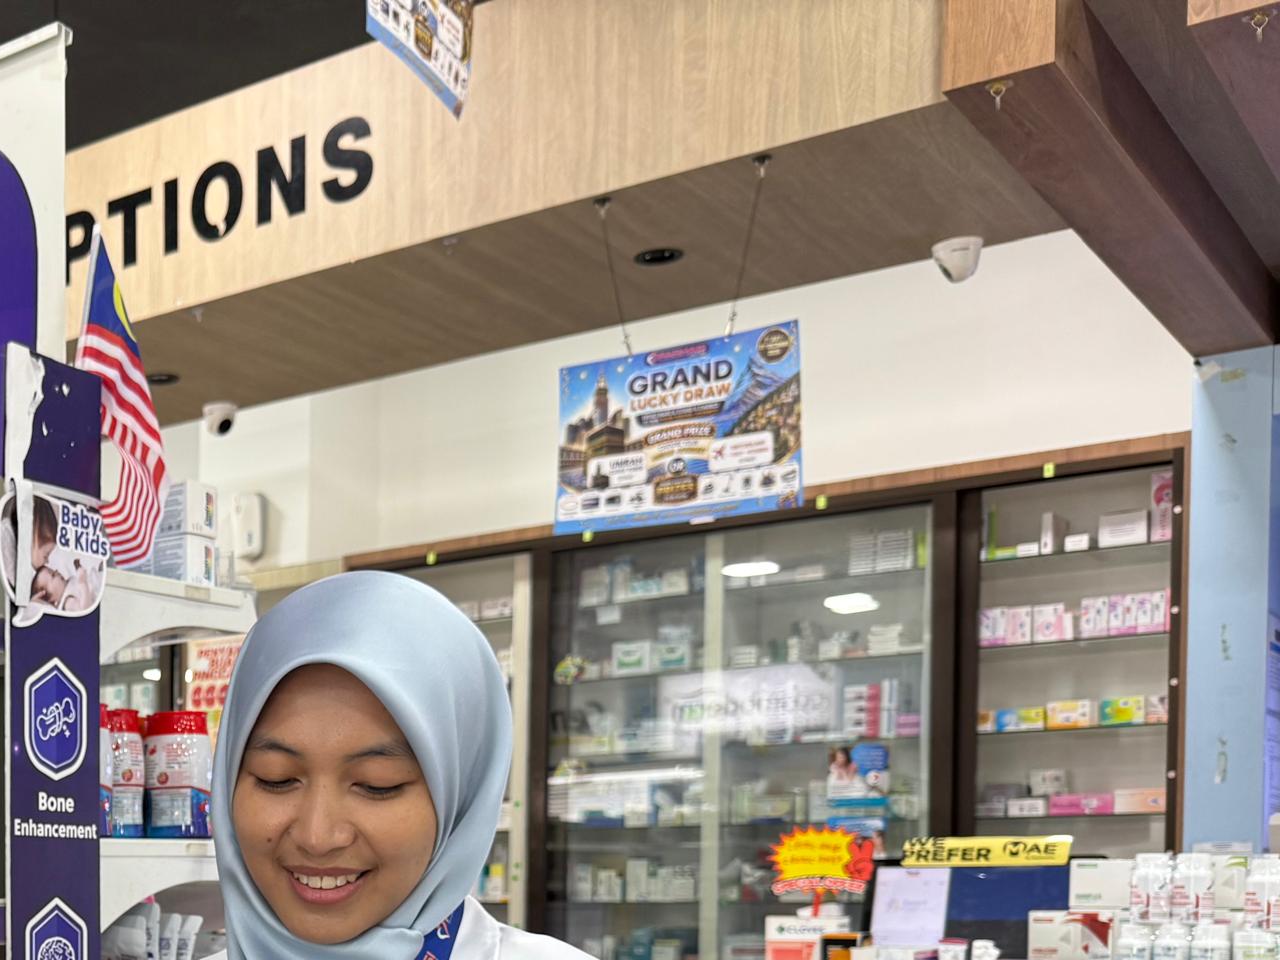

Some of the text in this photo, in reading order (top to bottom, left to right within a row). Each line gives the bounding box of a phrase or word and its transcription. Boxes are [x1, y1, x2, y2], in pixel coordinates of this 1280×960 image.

[66, 116, 374, 287] PTIONS
[629, 360, 733, 395] GRAND
[631, 382, 731, 412] LUCKY DRAW
[61, 504, 101, 534] Baby
[59, 530, 108, 557] & Kids
[38, 791, 75, 813] Bone
[14, 818, 97, 840] Enhancement
[903, 847, 991, 863] PREFER
